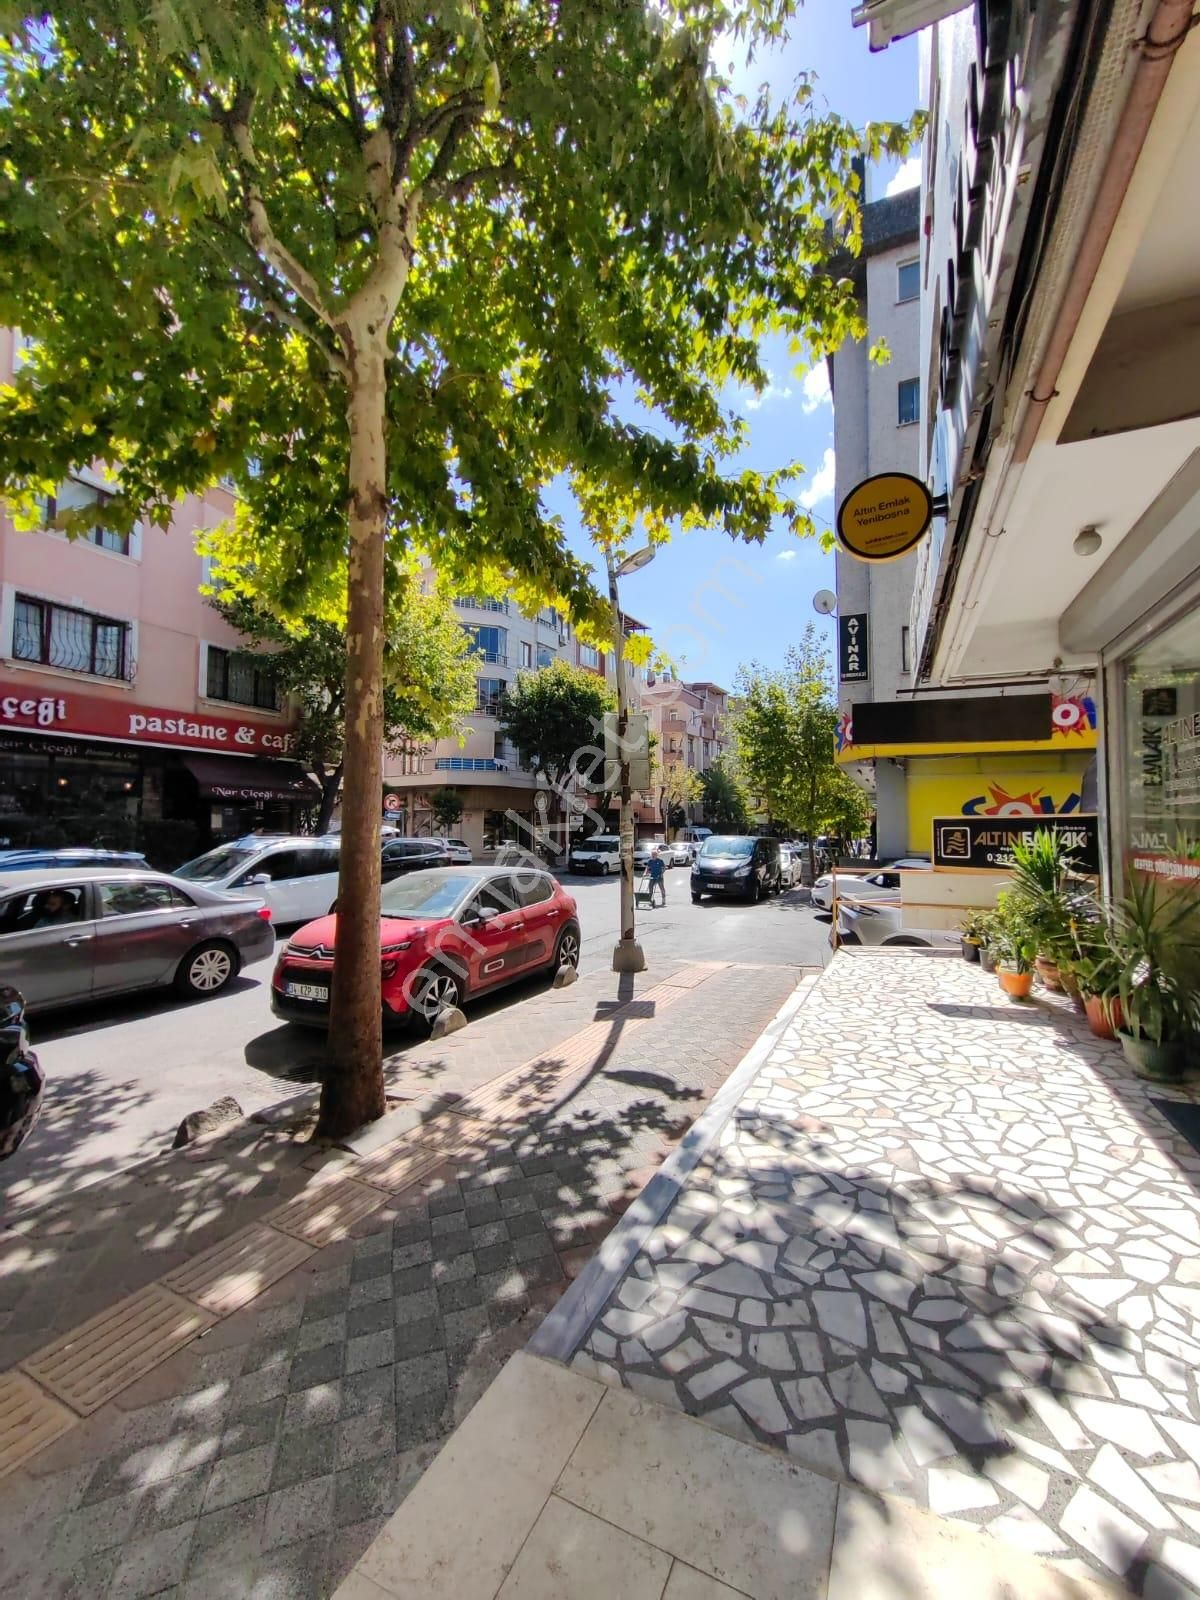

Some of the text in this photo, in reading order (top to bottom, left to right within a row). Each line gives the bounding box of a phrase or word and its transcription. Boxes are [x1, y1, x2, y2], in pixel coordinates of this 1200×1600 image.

[878, 496, 910, 510] Emlak
[857, 508, 910, 526] Yenibosna
[129, 714, 227, 741] pastane
[235, 726, 255, 745] &
[1142, 727, 1162, 786] EMLAK
[212, 787, 238, 797] Nar
[240, 789, 273, 800] Çiçeği
